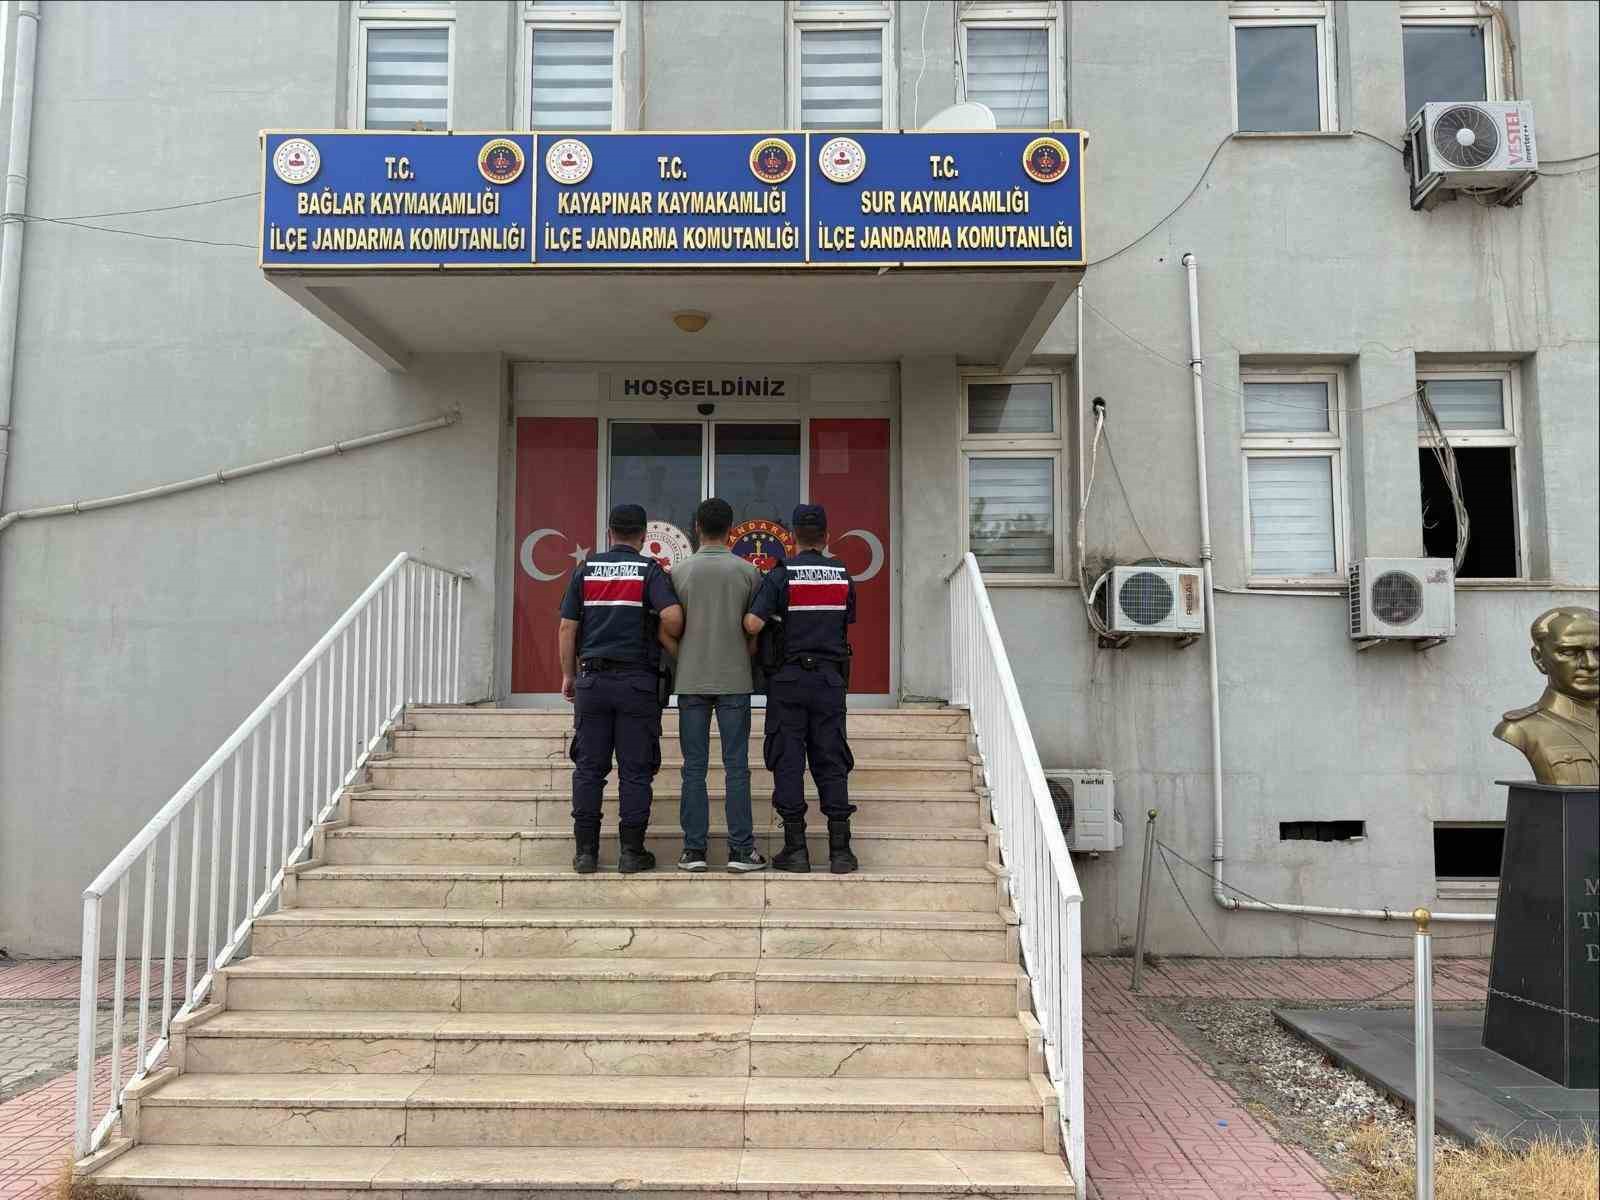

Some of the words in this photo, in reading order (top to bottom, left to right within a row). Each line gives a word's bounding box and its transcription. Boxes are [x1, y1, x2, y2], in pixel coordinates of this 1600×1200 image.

[1504, 109, 1522, 164] VESTEL
[385, 157, 414, 179] T.C.
[658, 157, 687, 178] T.C.
[930, 155, 959, 177] T.C.
[297, 186, 365, 215] BAĞLAR
[370, 186, 499, 214] KAYMAKAMLIĞI
[558, 191, 653, 214] KAYAPINAR
[657, 186, 786, 213] KAYMAKAMLIĞI
[860, 190, 895, 213] SUR
[900, 185, 1028, 213] KAYMAKAMLIĞI
[270, 221, 307, 251] İLÇE
[312, 226, 403, 250] JANDARMA
[410, 221, 525, 249] KOMUTANLIĞI
[544, 221, 582, 251] İLÇE
[587, 226, 678, 249] JANDARMA
[683, 221, 799, 249] KOMUTANLIĞI
[818, 220, 854, 251] İLÇE
[860, 226, 951, 249] JANDARMA
[957, 221, 1072, 248] KOMUTANLIĞI
[624, 376, 785, 400] HOŞGELDİNİZ
[728, 522, 794, 557] ANDARMA
[591, 565, 639, 577] JANDARMA
[794, 568, 841, 581] JANDARMA
